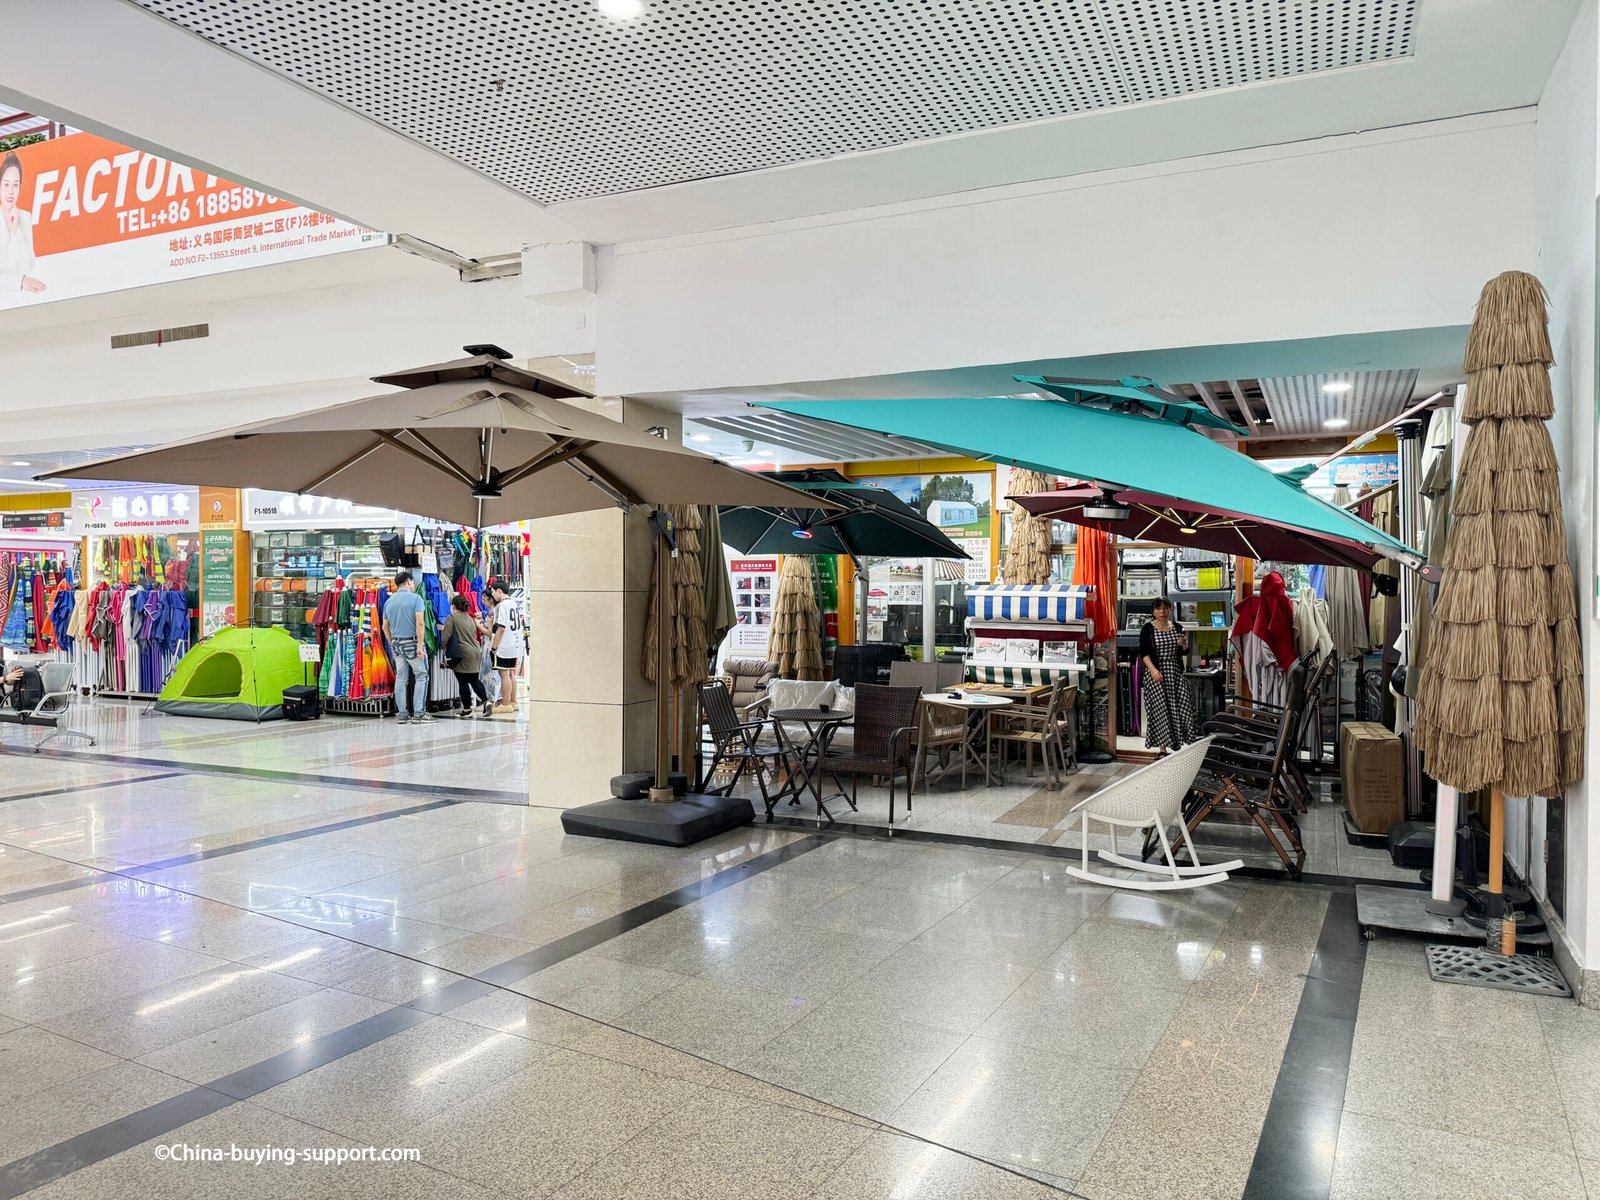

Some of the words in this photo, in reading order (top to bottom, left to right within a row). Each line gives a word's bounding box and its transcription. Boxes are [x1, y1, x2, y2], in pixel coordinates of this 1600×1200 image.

[31, 149, 218, 226] FACTOR
[260, 237, 305, 252] International
[306, 233, 328, 244] Trade
[328, 228, 355, 240] Market
[113, 520, 155, 528] Confidence
[155, 518, 189, 526] umbrella
